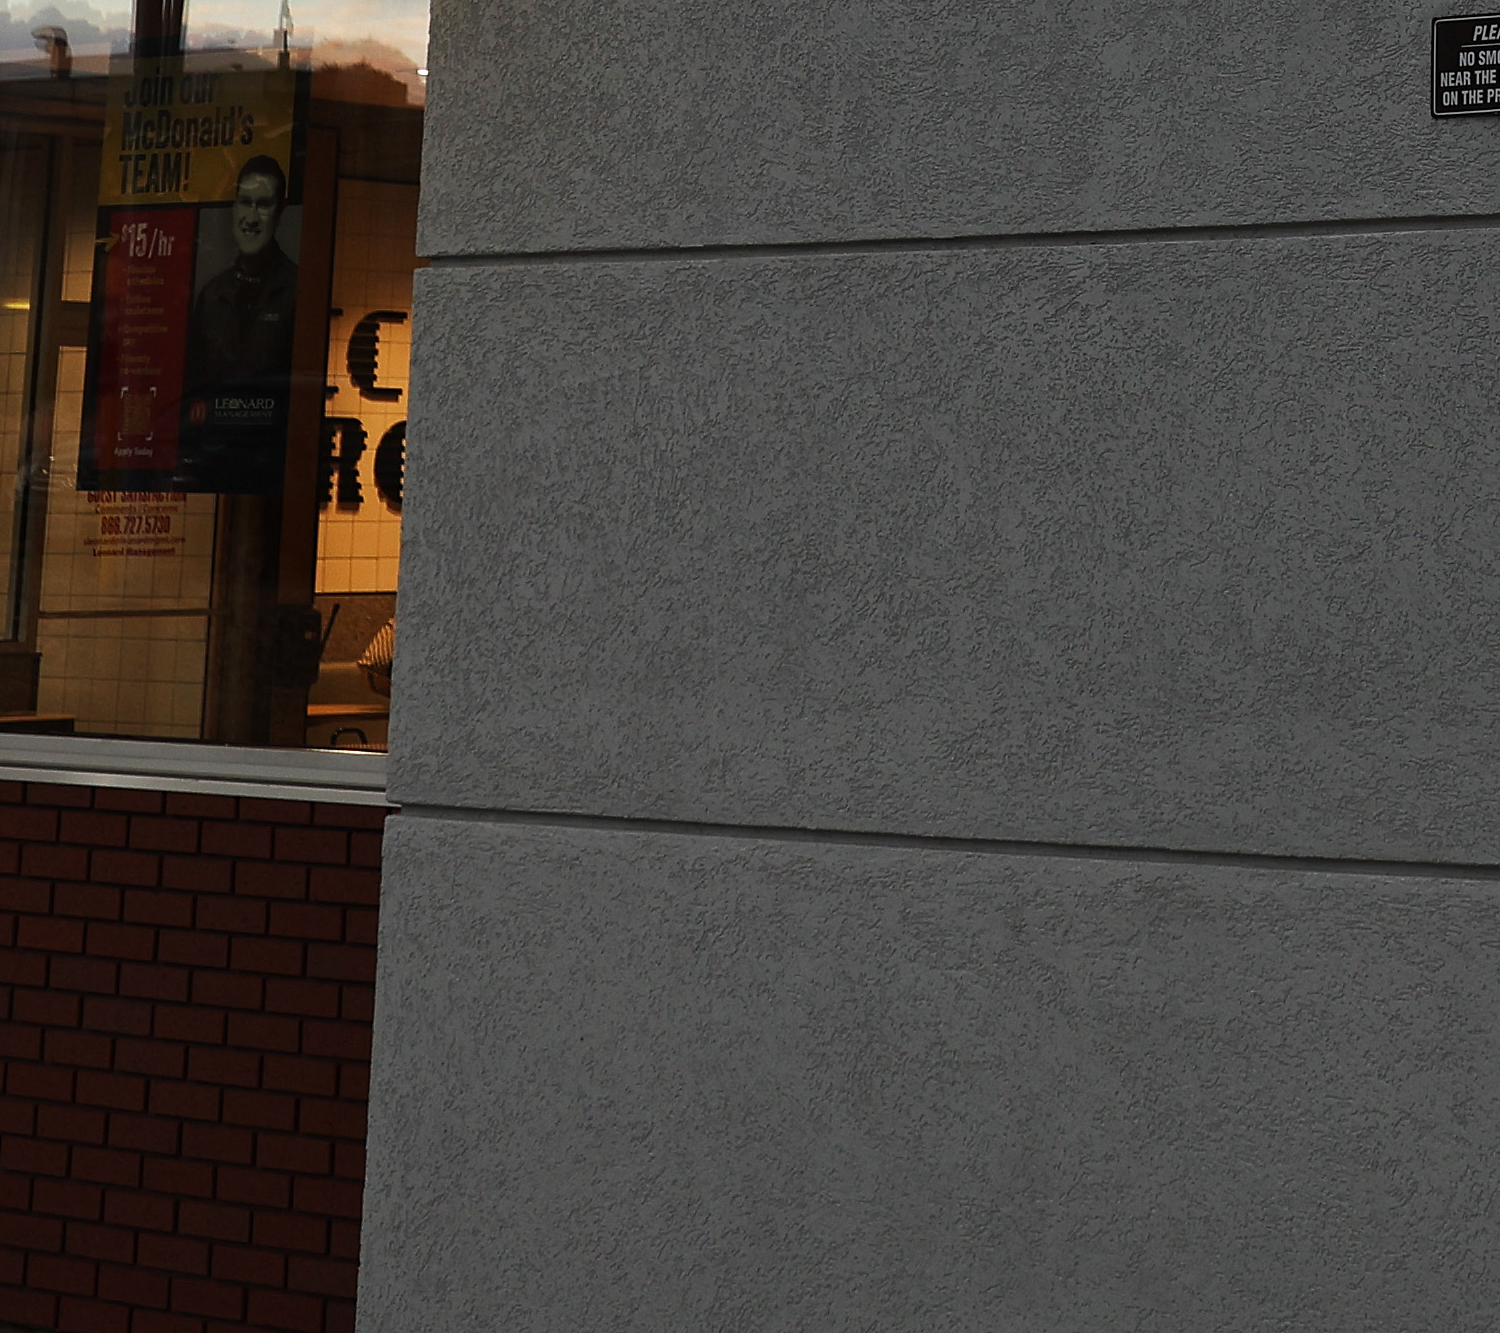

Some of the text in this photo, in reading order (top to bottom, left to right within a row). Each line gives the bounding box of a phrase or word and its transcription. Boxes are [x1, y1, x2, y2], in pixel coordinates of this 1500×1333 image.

[1459, 51, 1475, 67] NO
[124, 67, 216, 107] Join our
[1440, 71, 1471, 87] NEAR
[1474, 69, 1497, 84] THE
[1442, 91, 1458, 107] ON
[1462, 89, 1483, 105] THE
[122, 106, 254, 151] McDonald's
[119, 152, 191, 194] TEAM!
[121, 222, 176, 259] $15/hr
[215, 398, 274, 409] LEONARD
